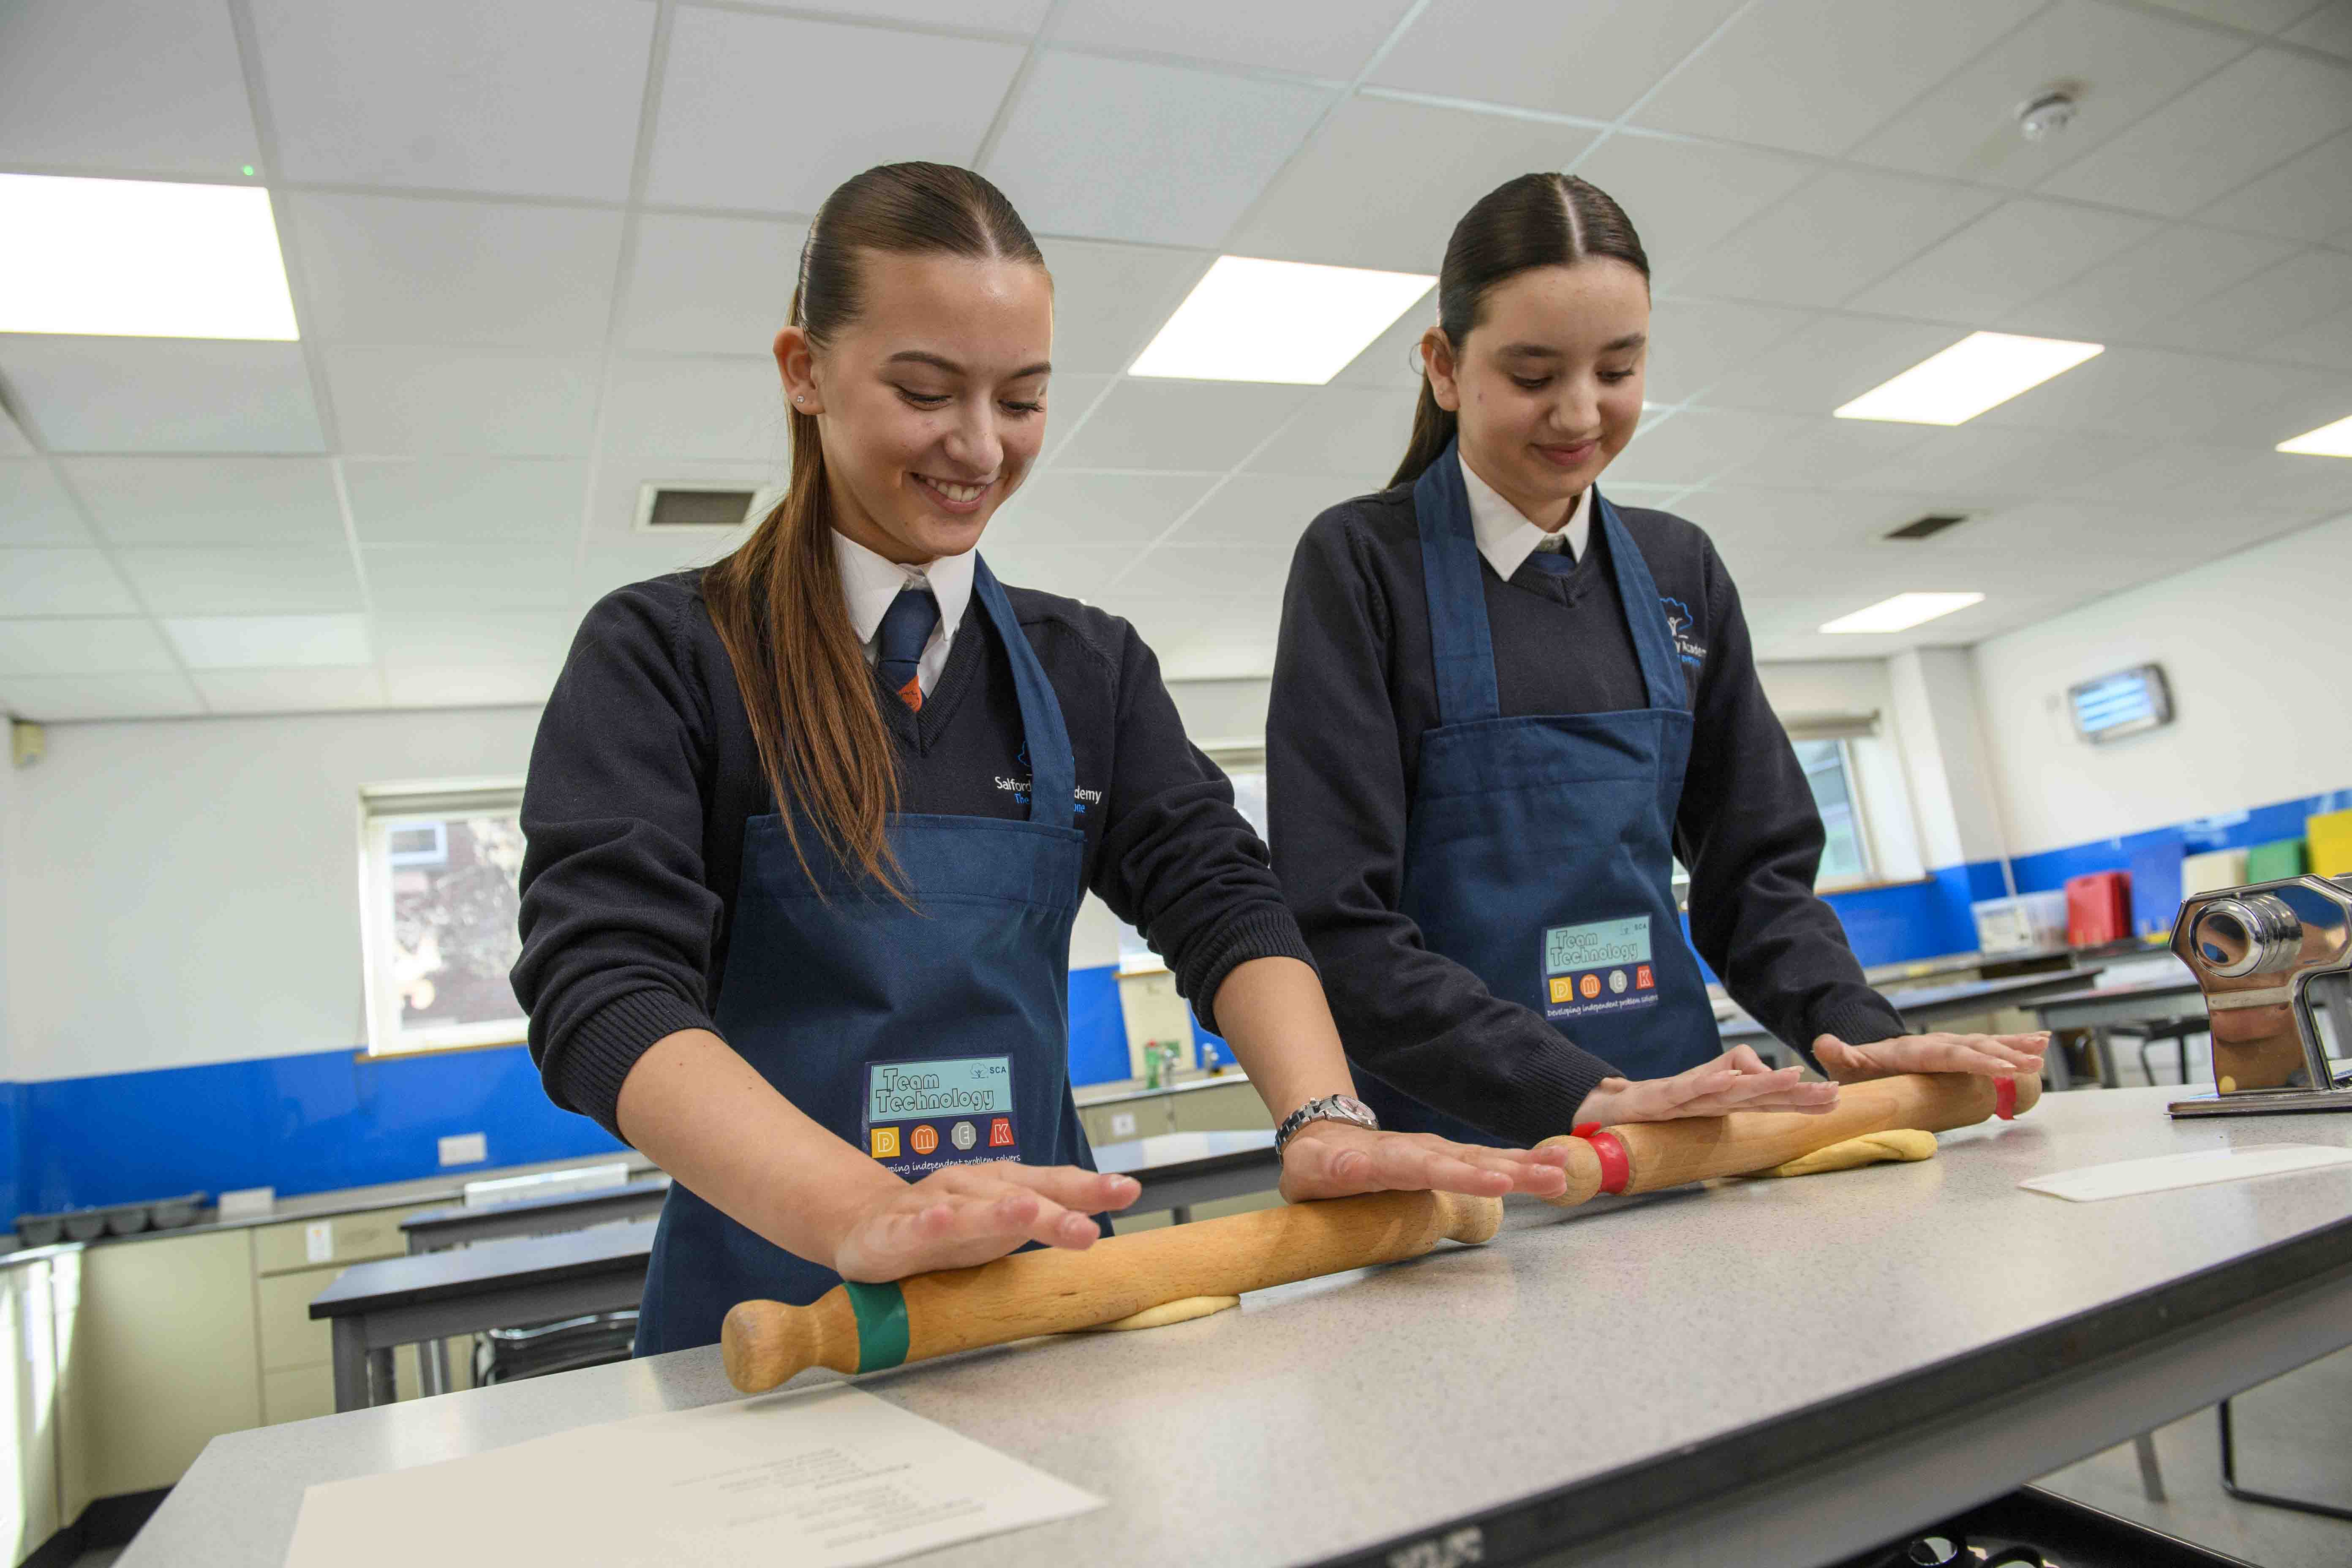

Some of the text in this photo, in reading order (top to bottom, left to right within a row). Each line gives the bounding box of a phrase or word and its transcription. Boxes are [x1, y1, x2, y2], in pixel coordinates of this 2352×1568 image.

[995, 776, 1102, 804] Salford demy
[1557, 930, 1598, 949] Team
[1551, 943, 1638, 966] Technology
[1547, 1006, 1582, 1017] Developing
[1582, 1001, 1619, 1012] independent
[883, 1068, 939, 1092] Team
[876, 1089, 994, 1112] Technology
[912, 1160, 962, 1173] independent
[996, 1154, 1021, 1162] solvers
